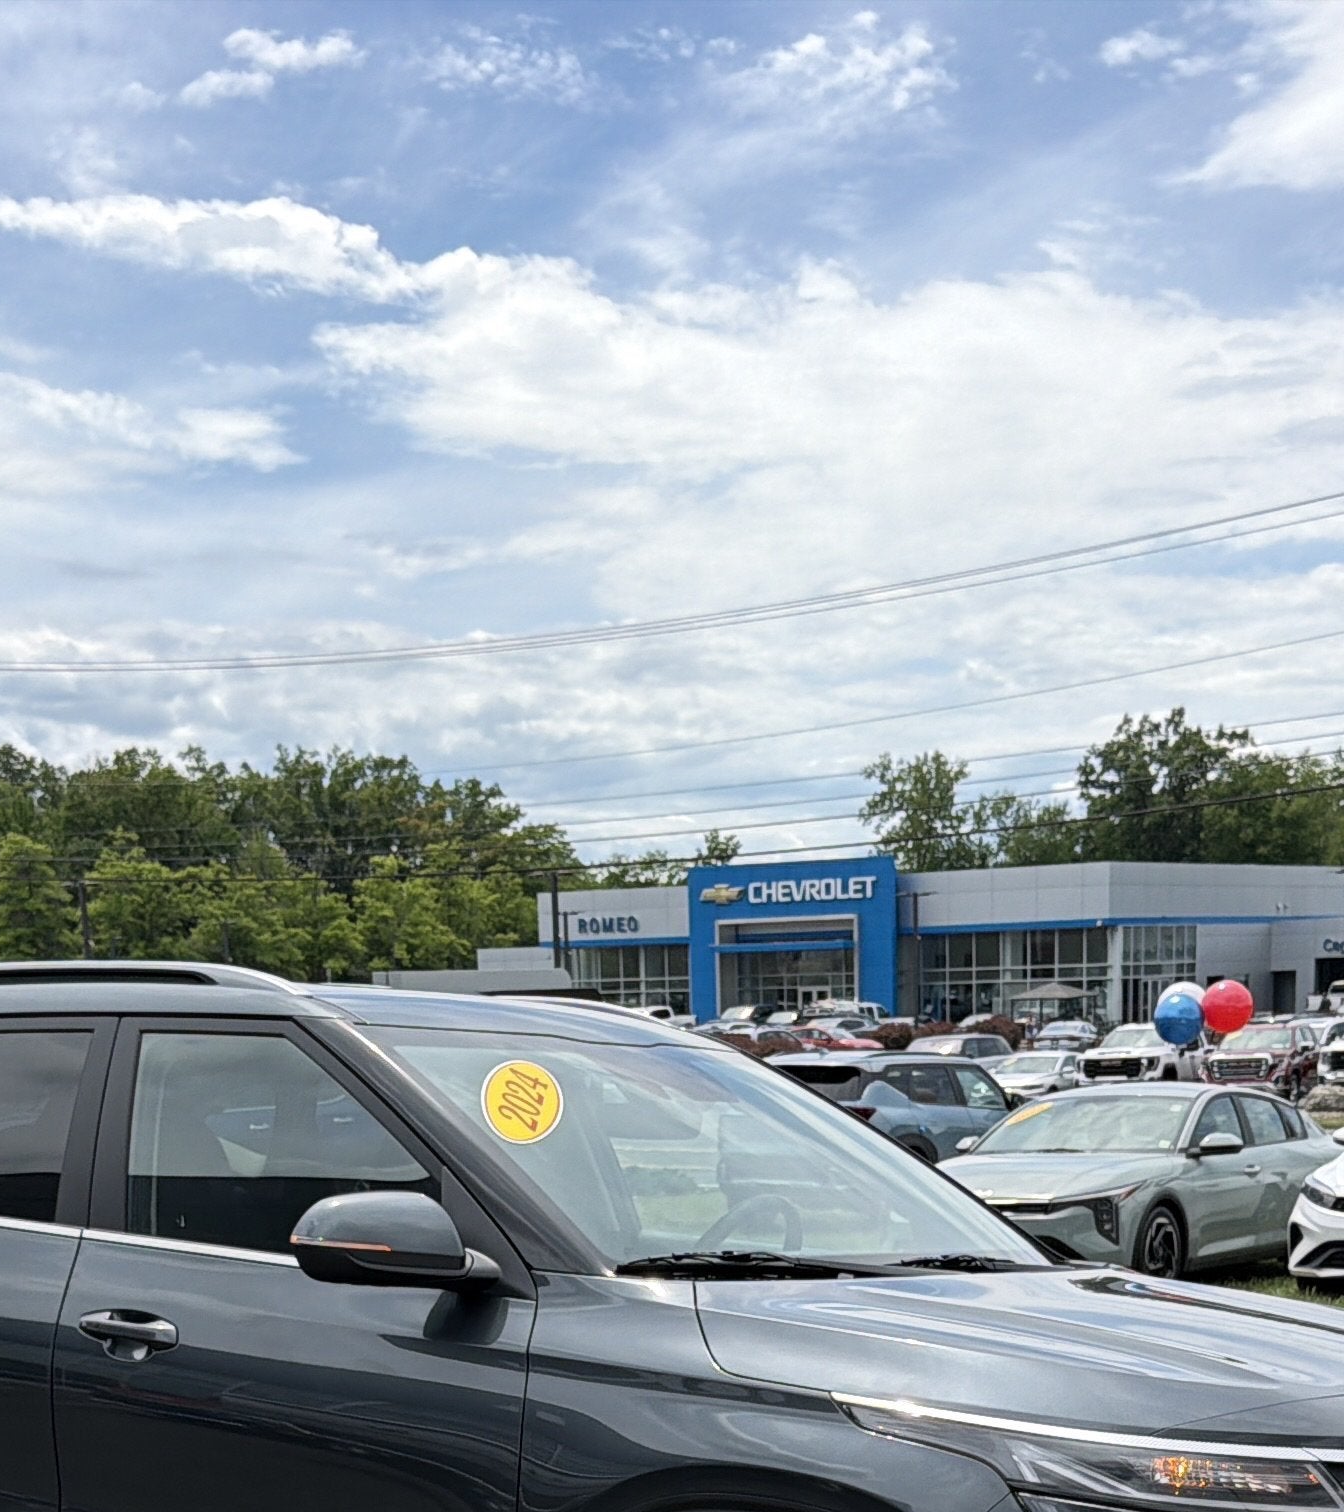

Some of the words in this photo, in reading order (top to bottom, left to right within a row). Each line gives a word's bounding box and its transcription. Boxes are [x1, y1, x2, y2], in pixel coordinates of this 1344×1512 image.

[748, 876, 876, 903] CHEVROLET
[577, 916, 640, 935] ROMEO
[497, 1067, 548, 1132] 2024
